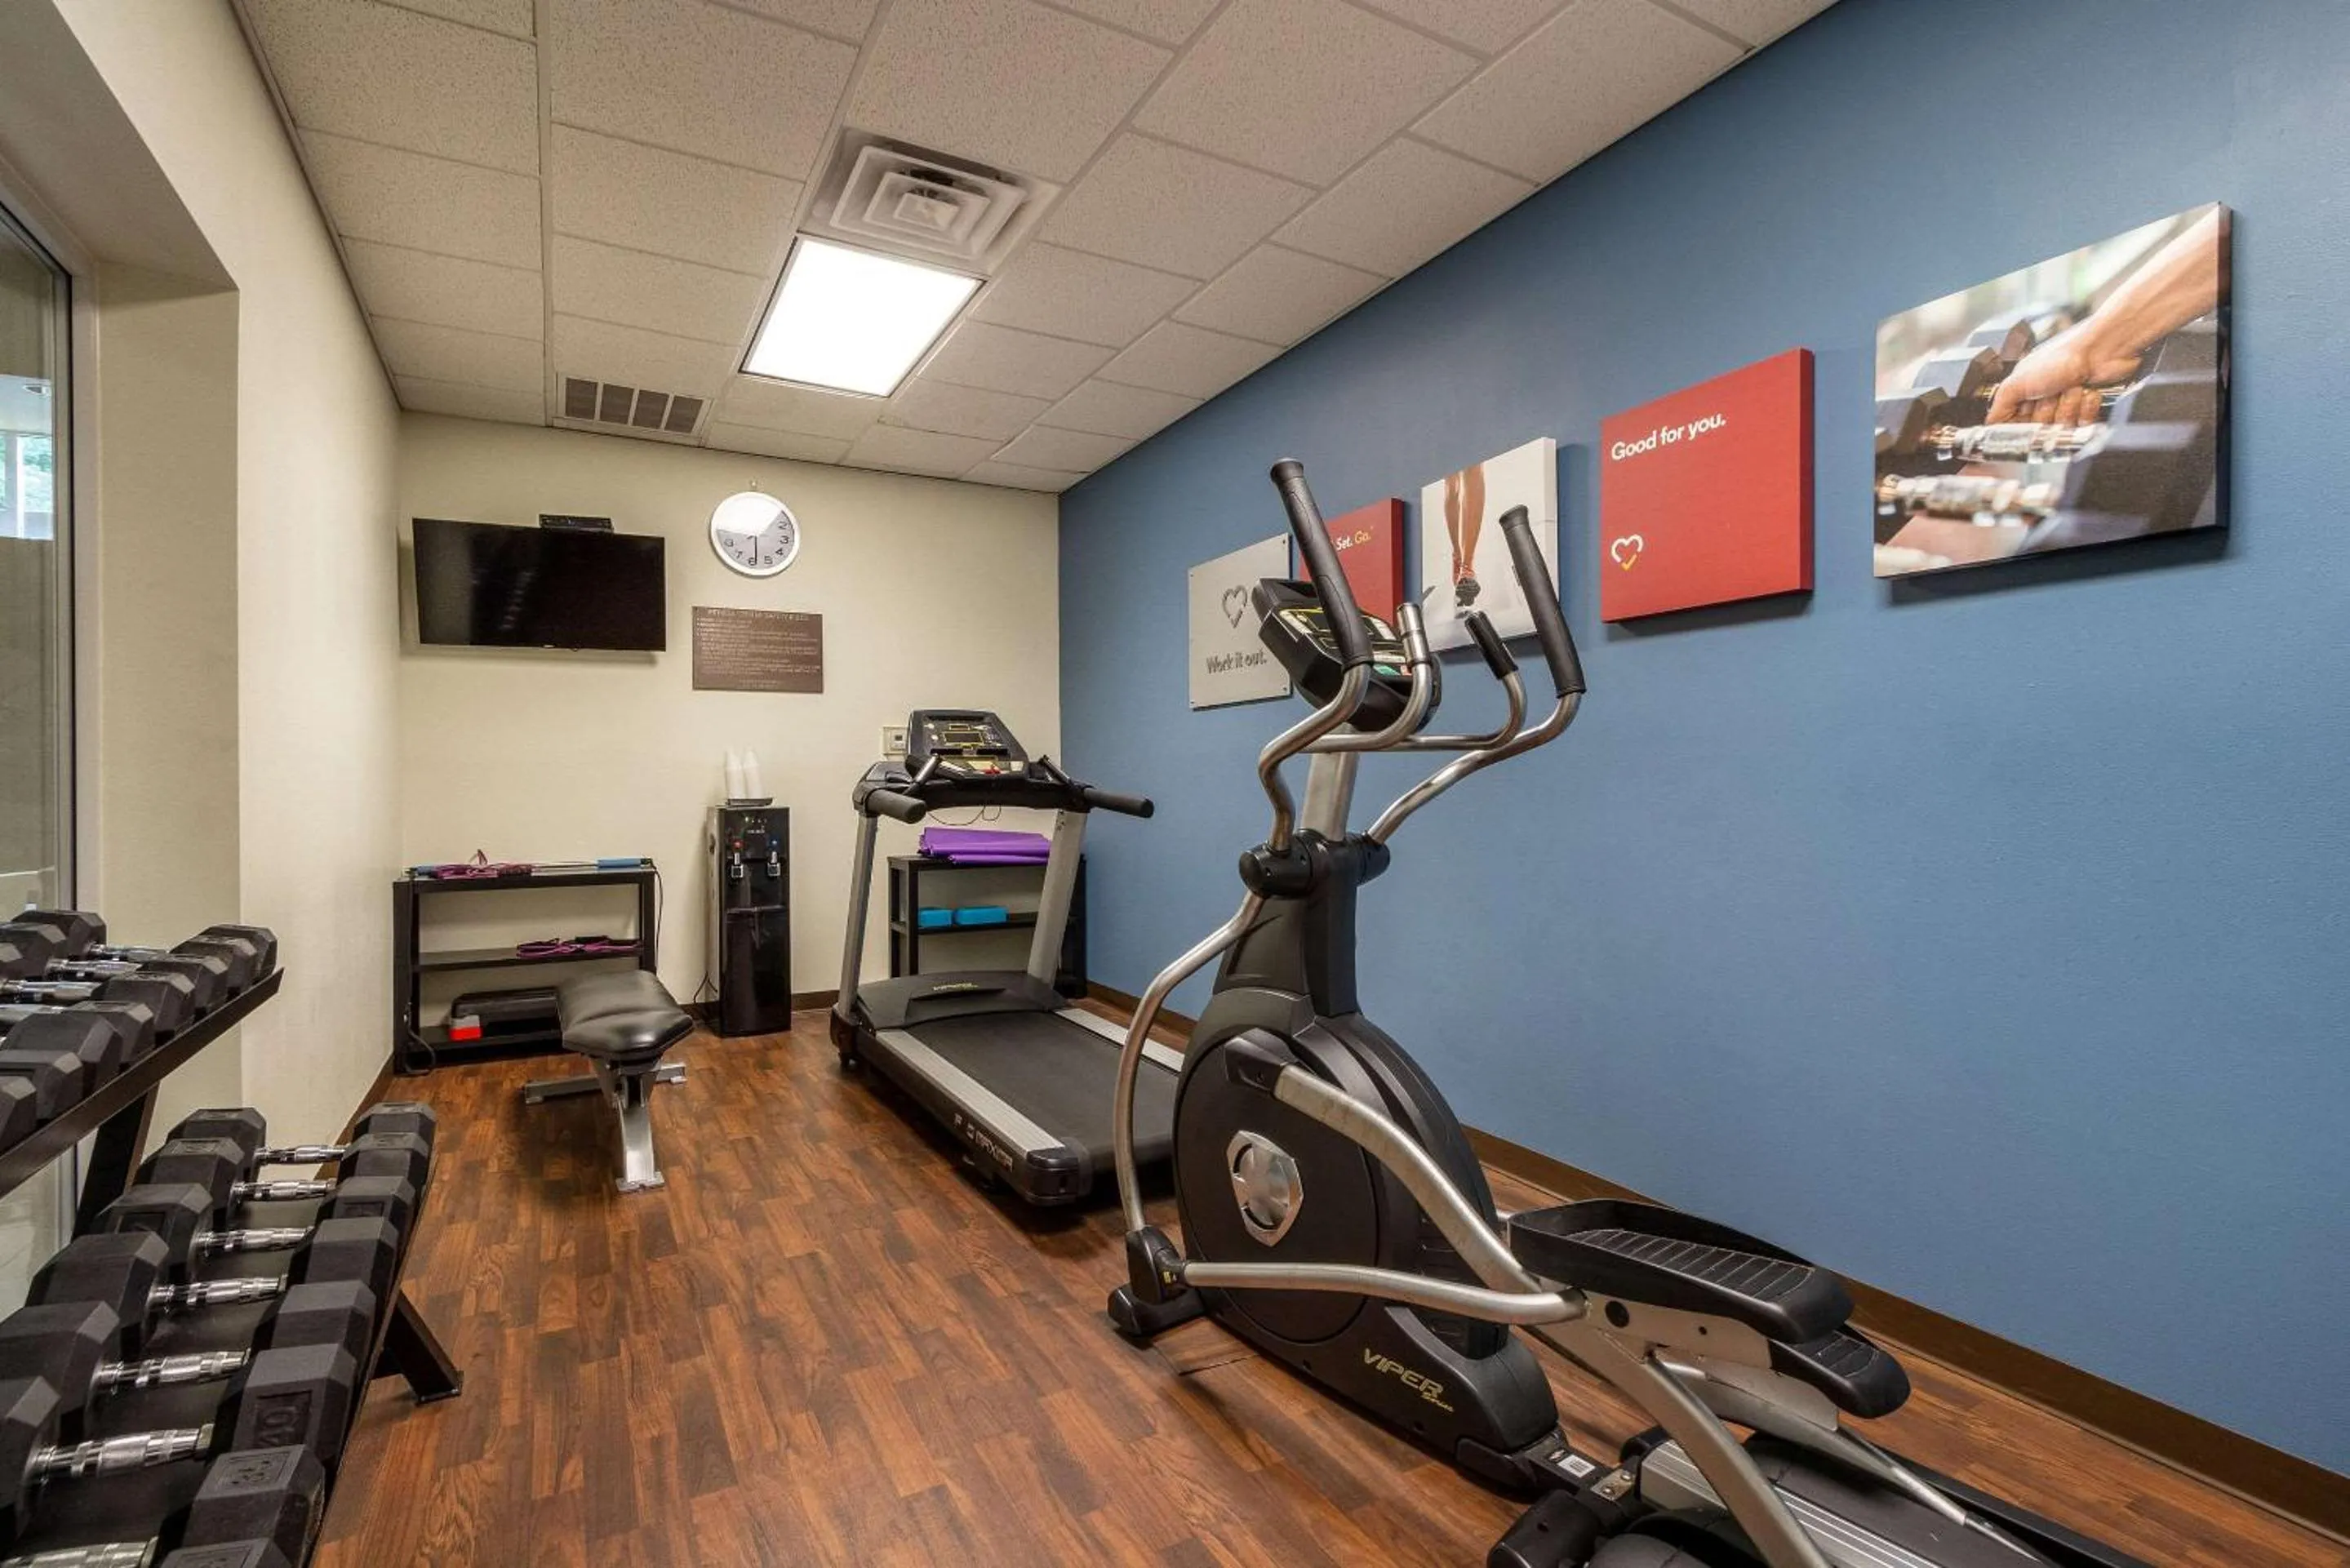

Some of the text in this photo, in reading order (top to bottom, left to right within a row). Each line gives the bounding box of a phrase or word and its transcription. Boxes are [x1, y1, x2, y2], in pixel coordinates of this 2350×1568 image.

[1611, 412, 1726, 460] Good for you.
[780, 535, 790, 544] 3
[1335, 530, 1371, 551] Set. Go.
[1363, 1348, 1444, 1399] VIPER
